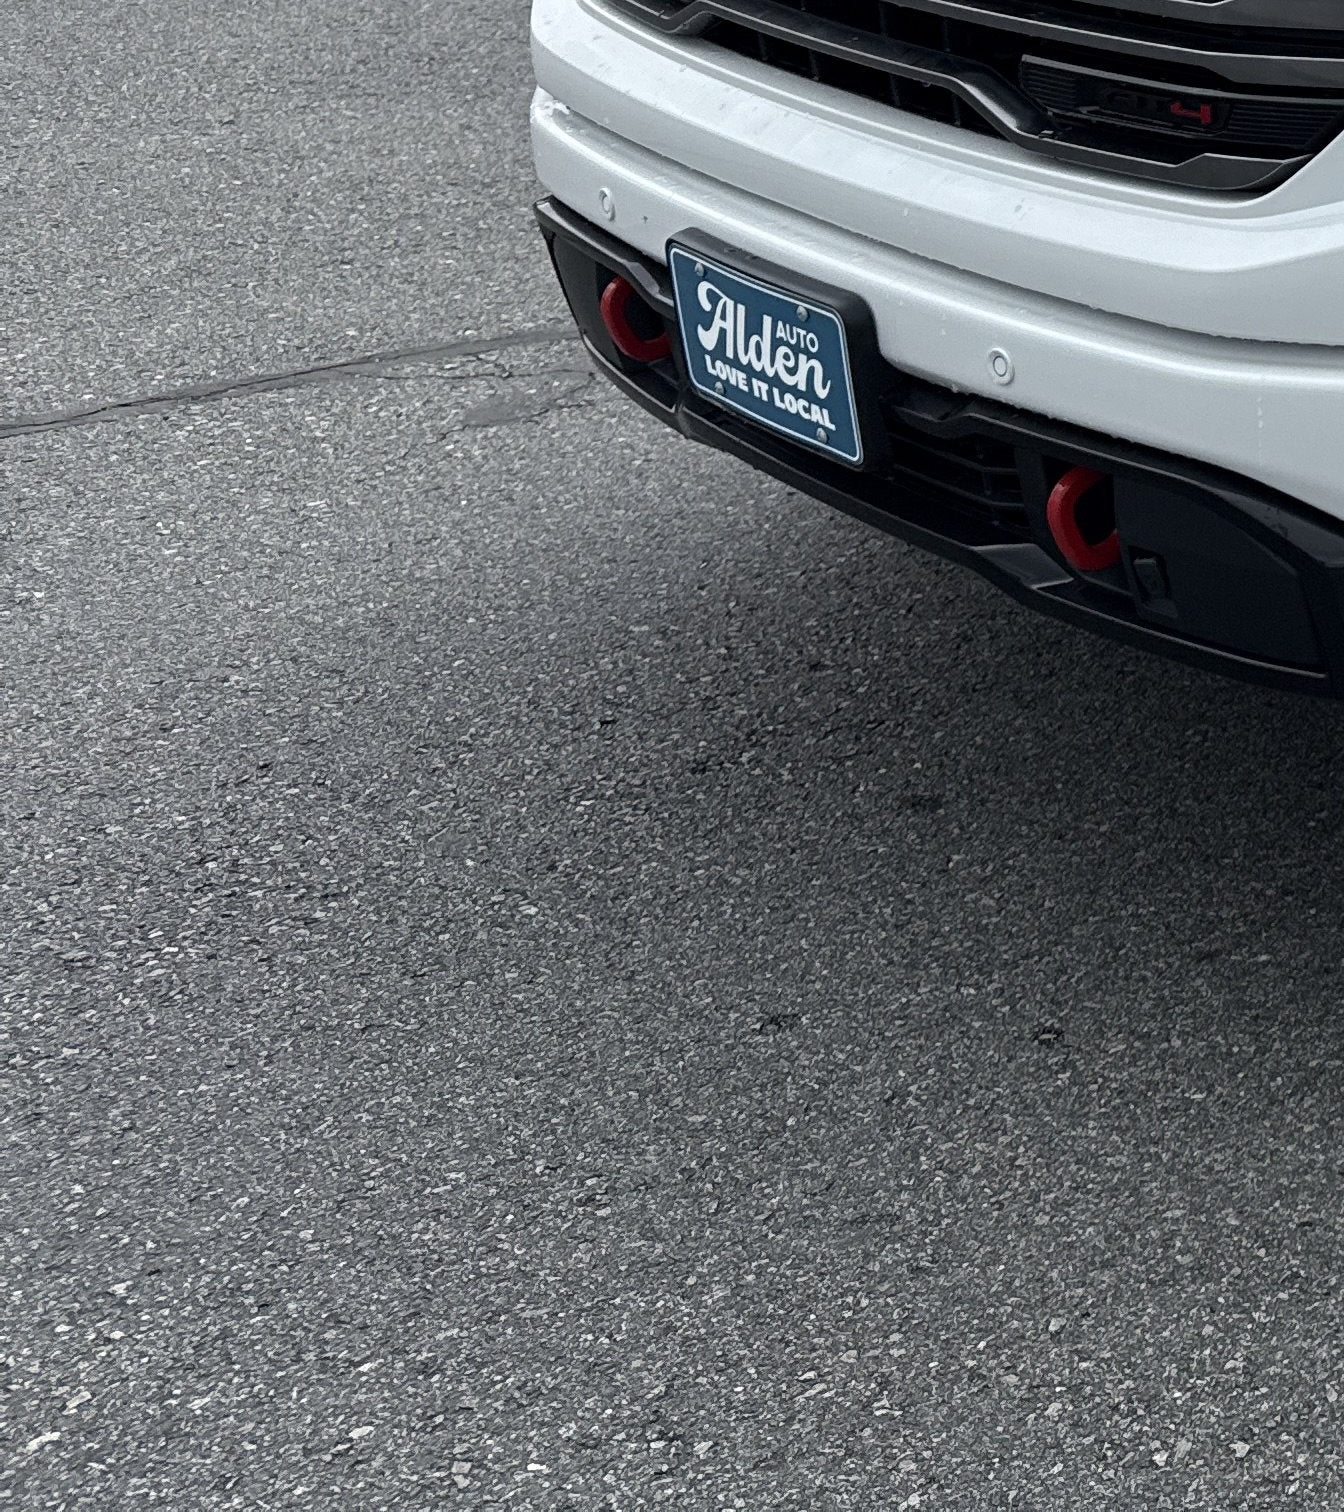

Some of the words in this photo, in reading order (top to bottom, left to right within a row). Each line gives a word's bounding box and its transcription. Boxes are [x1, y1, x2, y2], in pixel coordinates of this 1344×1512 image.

[697, 280, 831, 400] Alden
[775, 320, 819, 353] AUTO
[704, 354, 748, 392] LOVE
[752, 377, 769, 402] IT
[772, 386, 836, 431] LOCAL
